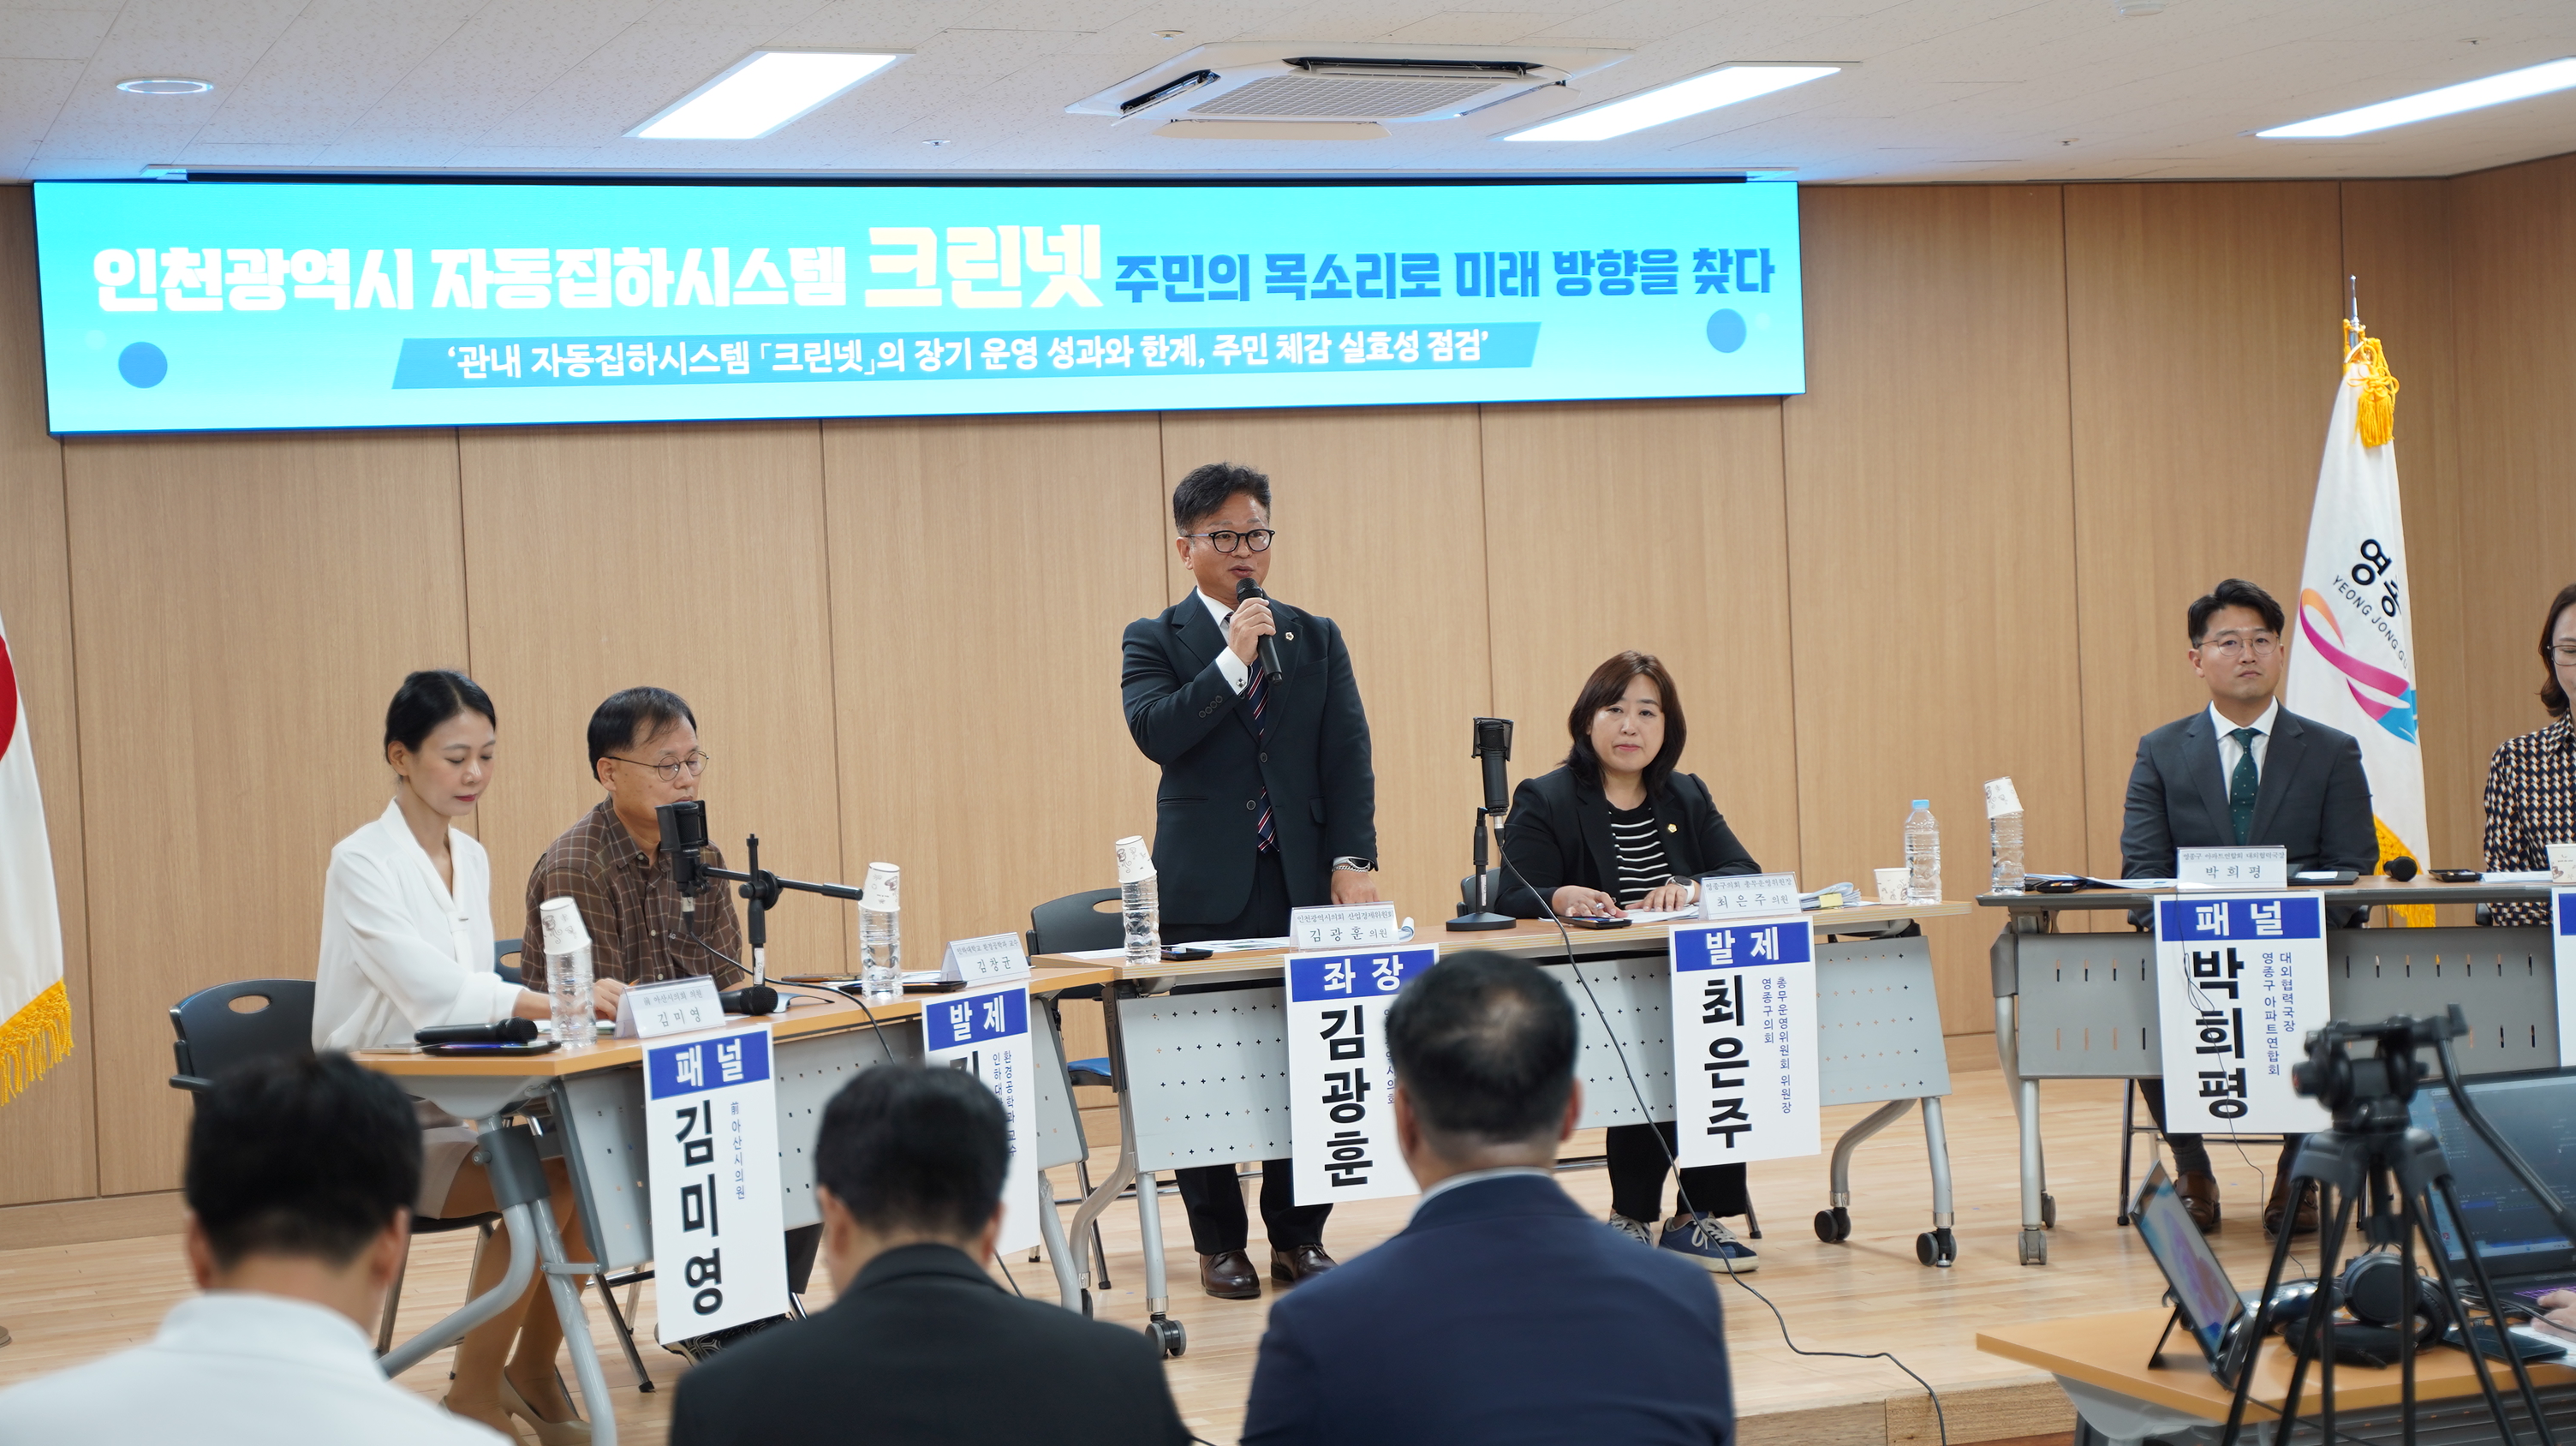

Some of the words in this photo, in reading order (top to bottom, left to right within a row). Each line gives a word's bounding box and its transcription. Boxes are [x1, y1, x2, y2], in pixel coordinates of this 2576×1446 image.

[92, 246, 414, 312] 인천광역시
[430, 245, 847, 310] 자동집하시스템
[864, 224, 1104, 309] 크린넷
[1114, 254, 1249, 303] 주민의
[1265, 251, 1440, 301] 목소리로
[1455, 250, 1540, 298] 미래
[1553, 248, 1679, 296] 방향을
[1692, 247, 1775, 295] 찾다
[530, 340, 750, 378] 자동집하시스템
[914, 336, 973, 372] 장기
[980, 334, 1039, 371] 운영
[1046, 333, 1134, 369] 성과와
[1139, 332, 1206, 367] 한계,
[1213, 332, 1270, 367] 주민
[1276, 331, 1332, 365] 체감
[1339, 330, 1421, 363] 실효성
[2332, 575, 2372, 617] YEONG
[2371, 616, 2399, 650] JONG
[2398, 649, 2408, 670] GU
[1706, 881, 1741, 892] 영종구의회
[2205, 865, 2261, 879] 박희평
[1297, 912, 1345, 923] 인천광역시의회
[1348, 910, 1393, 921] 산업경제위원회
[1717, 893, 1767, 909] 최은주
[1772, 894, 1789, 905] 의원
[2195, 901, 2283, 936] 패널
[1310, 926, 1363, 942] 김광훈
[1369, 928, 1388, 939] 의원
[1705, 926, 1780, 965] 발제
[977, 955, 1011, 973] 김창균
[1323, 954, 1404, 994] 좌장
[2262, 952, 2275, 991] 영종구
[653, 991, 687, 1004] 아산시의회
[689, 989, 703, 999] 의원
[1762, 977, 1774, 1043] 영종구의회
[2280, 952, 2295, 1032] 대외협력국장
[658, 1007, 701, 1027] 김미영
[950, 995, 1005, 1042] 발제
[1776, 977, 1790, 1069] 총무운영위원회
[2192, 947, 2248, 1119] 박희평
[2264, 996, 2280, 1076] 아파트연합회
[675, 1037, 743, 1087] 패널
[1702, 974, 1752, 1149] 최은주
[1004, 1050, 1015, 1123] 환경공학과
[1320, 1004, 1373, 1187] 김광훈
[1780, 1074, 1792, 1114] 위원장
[675, 1099, 724, 1316] 김미영
